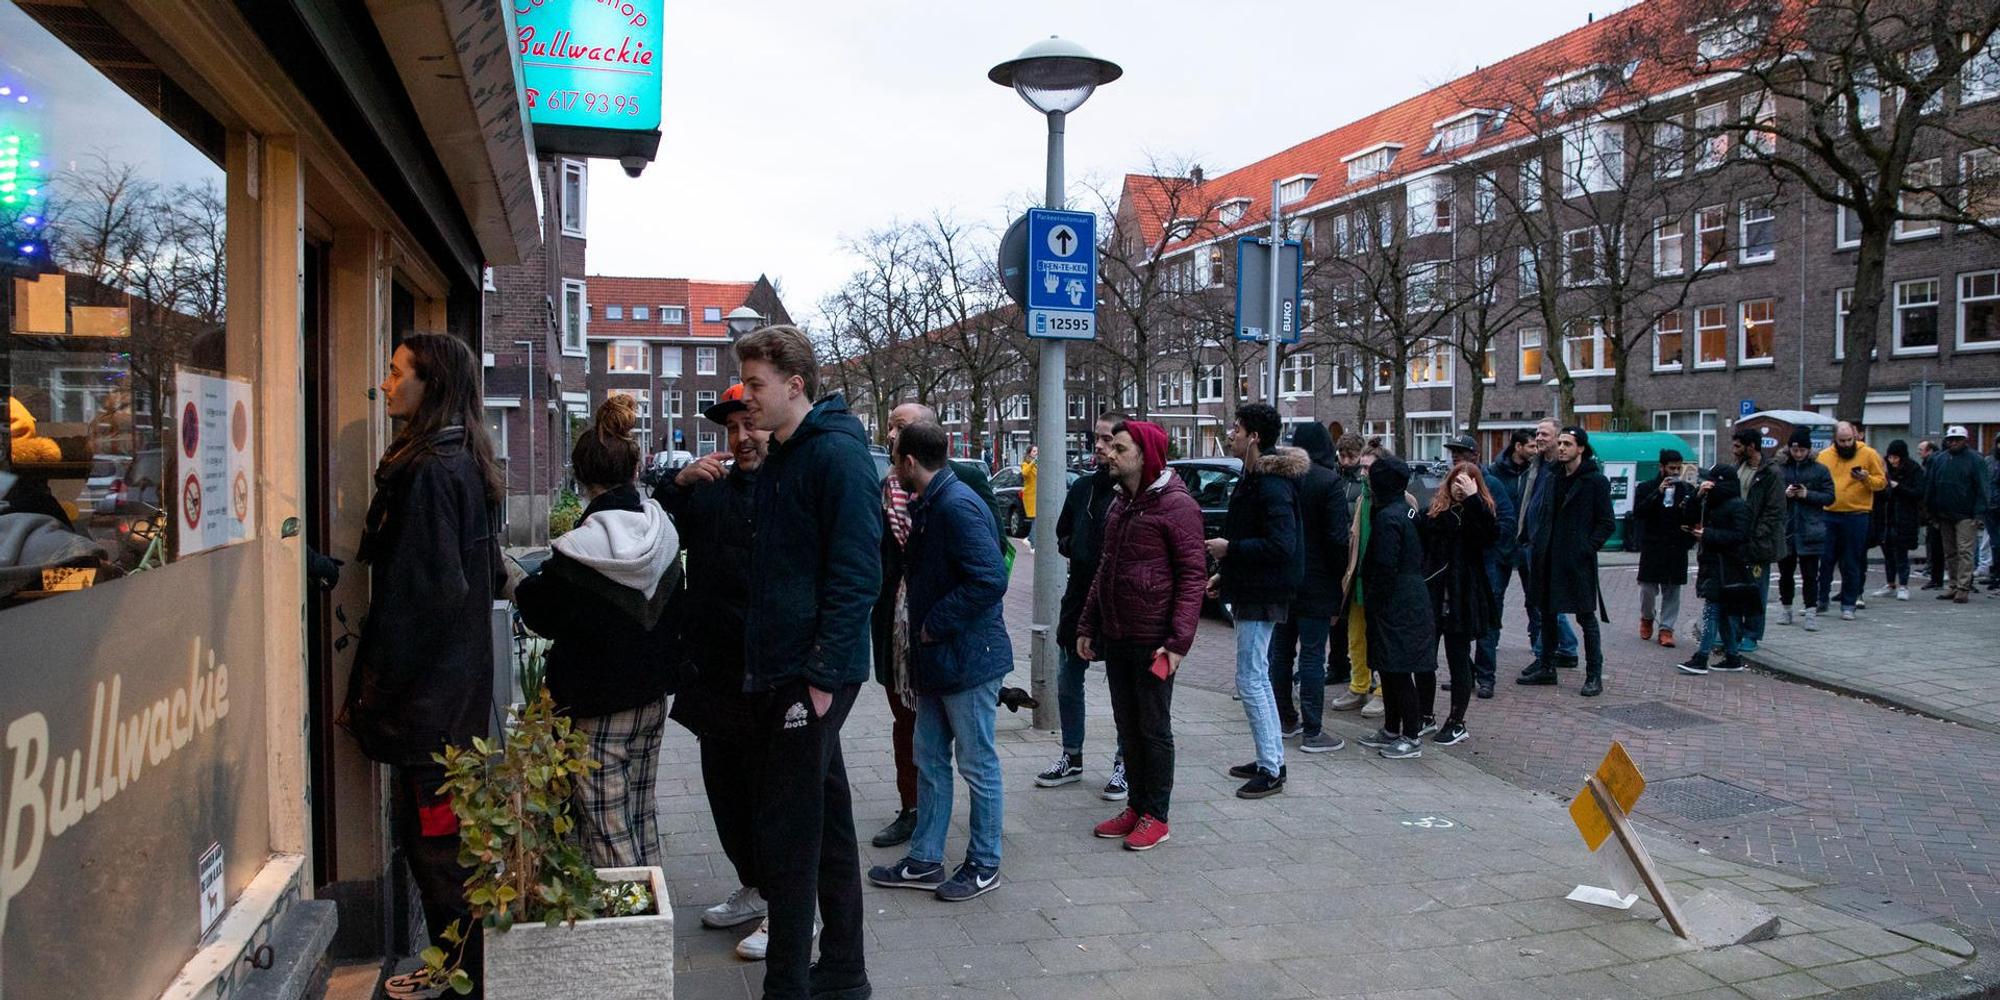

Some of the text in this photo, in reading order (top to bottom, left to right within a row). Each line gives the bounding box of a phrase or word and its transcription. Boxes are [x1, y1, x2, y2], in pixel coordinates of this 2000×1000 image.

[517, 26, 653, 65] Bullwackie
[547, 89, 640, 116] 617 93 95
[1050, 318, 1089, 331] 12595
[1283, 301, 1292, 332] BUKO
[1742, 402, 1751, 413] P
[0, 636, 230, 936] Bullwackie
